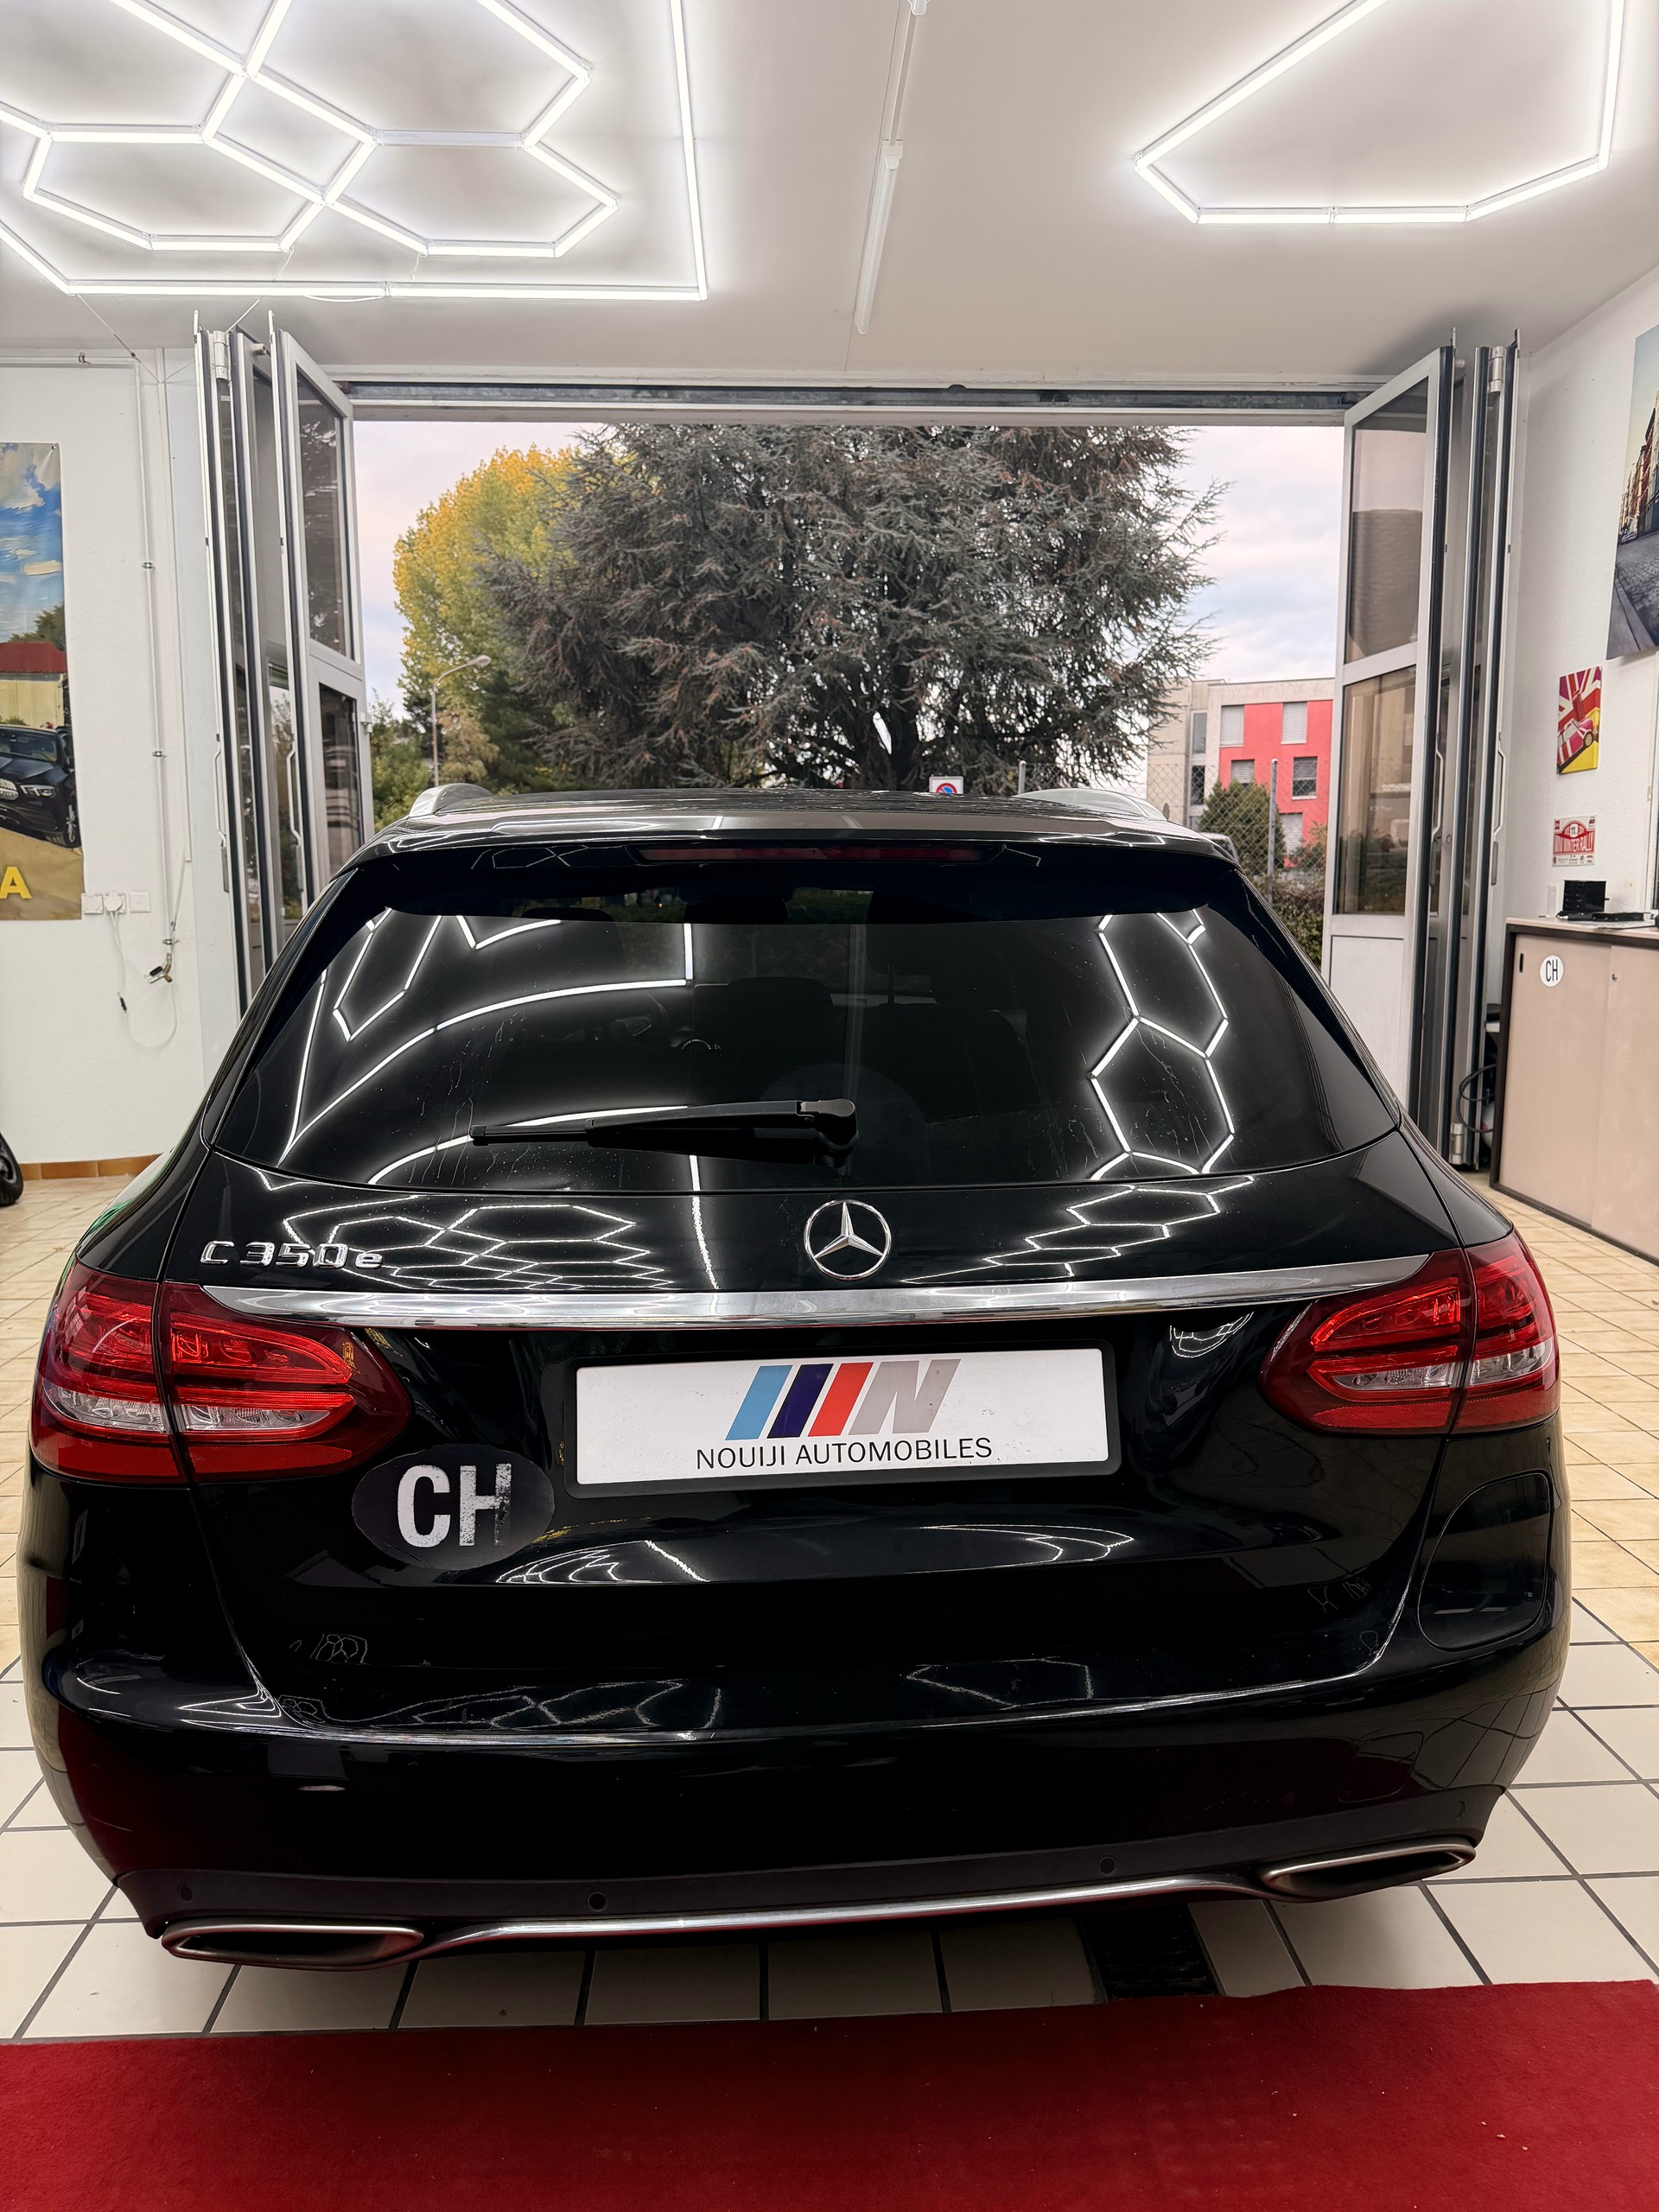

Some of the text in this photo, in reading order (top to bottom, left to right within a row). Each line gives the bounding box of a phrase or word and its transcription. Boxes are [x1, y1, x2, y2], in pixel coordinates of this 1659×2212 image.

[0, 866, 33, 899] A
[1545, 959, 1559, 982] CH
[696, 1436, 994, 1470] NOUIJI AUTOMOBILES
[397, 1463, 512, 1548] CH
